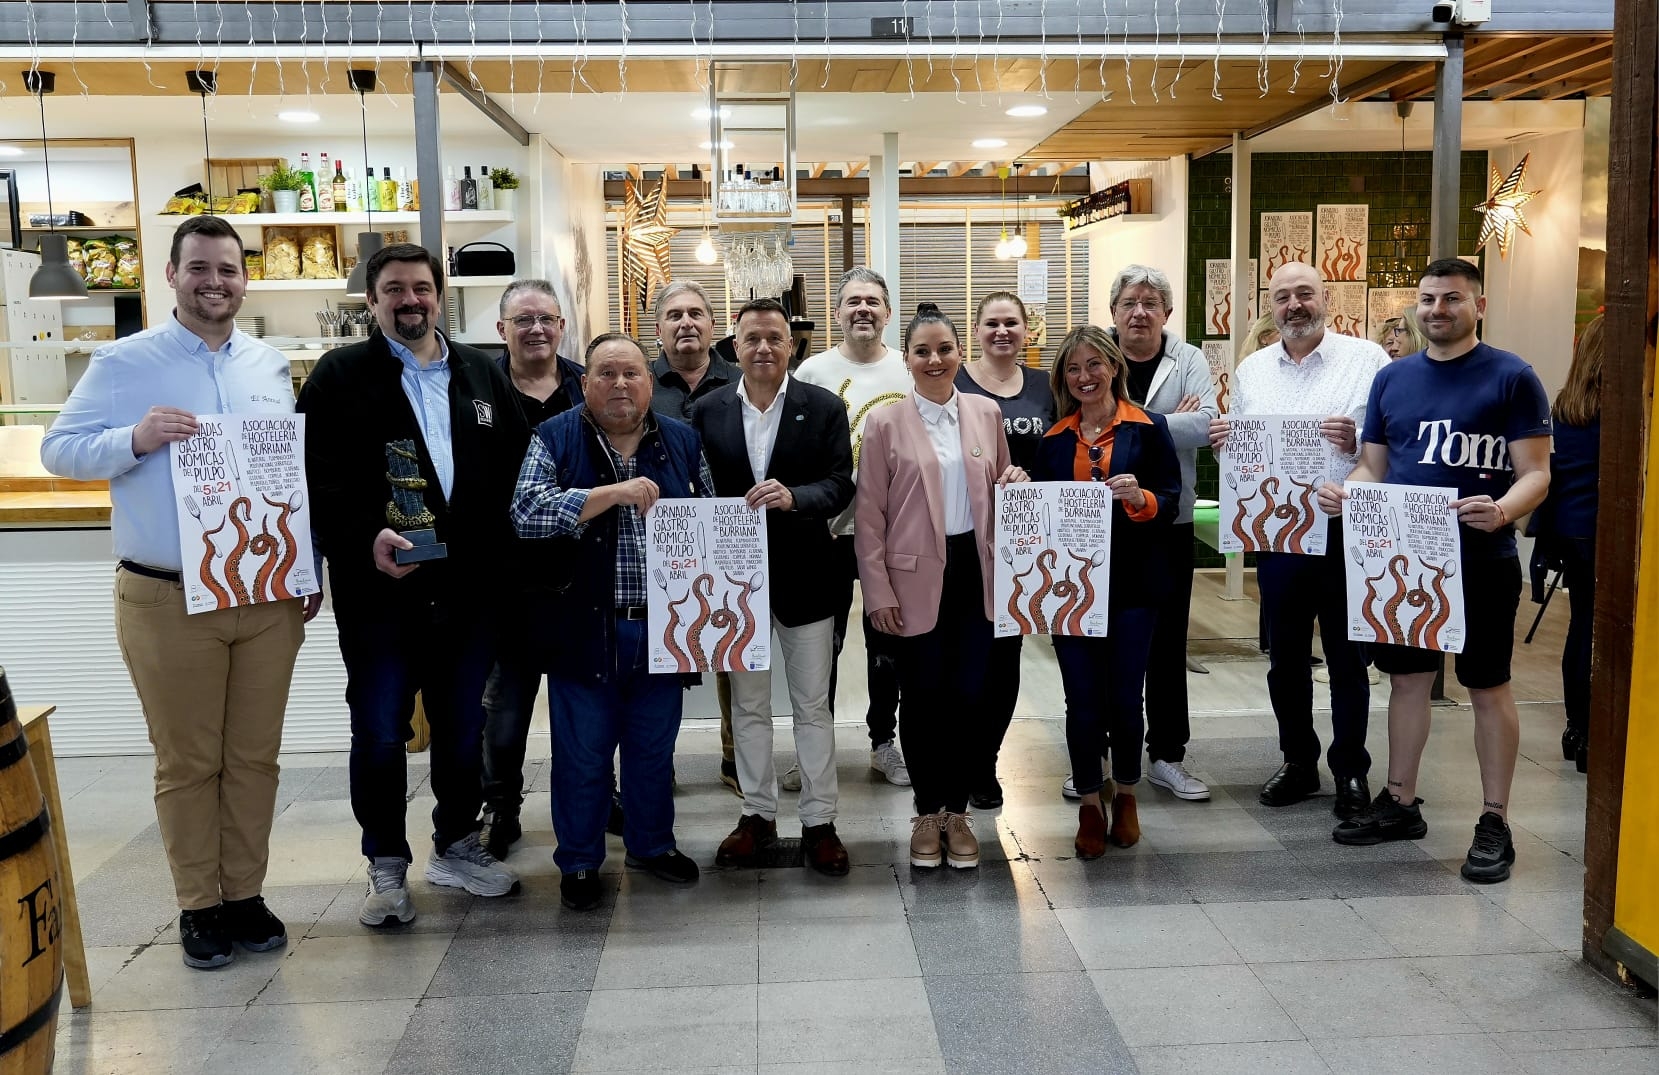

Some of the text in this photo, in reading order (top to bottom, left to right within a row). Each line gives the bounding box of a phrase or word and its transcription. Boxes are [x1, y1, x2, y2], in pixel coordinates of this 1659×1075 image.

[194, 422, 222, 438] NADAS
[1228, 431, 1258, 442] GASTRO
[178, 438, 216, 453] GASTRO
[250, 442, 292, 456] BURRIANA
[1287, 439, 1321, 447] BURRIANA
[1417, 419, 1512, 471] Tom
[1237, 453, 1261, 463] PULPO
[184, 467, 225, 482] DEL PULPO
[203, 485, 211, 495] 5
[217, 481, 231, 492] 21
[1002, 488, 1042, 501] JORNADAS
[1349, 488, 1388, 502] JORNADAS
[202, 496, 223, 507] ABRIL
[1003, 501, 1034, 514] GASTRO
[1351, 501, 1381, 513] GASTRO
[653, 505, 696, 518] JORNADAS
[1065, 508, 1101, 518] BURRIANA
[655, 519, 688, 532] GASTRO
[1411, 514, 1447, 526] BURRIANA
[720, 527, 757, 537] BURRIANA
[1013, 524, 1038, 536] PULPO
[1362, 525, 1388, 537] PULPO
[1018, 538, 1024, 546] 5
[1030, 536, 1042, 545] 21
[1368, 540, 1374, 548] 5
[1380, 539, 1391, 548] 21
[666, 545, 693, 557] PULPO
[1016, 547, 1032, 555] ABRIL
[1366, 549, 1384, 558] ABRIL
[672, 560, 678, 569] 5
[684, 559, 697, 567] 21
[670, 570, 688, 579] ABRIL
